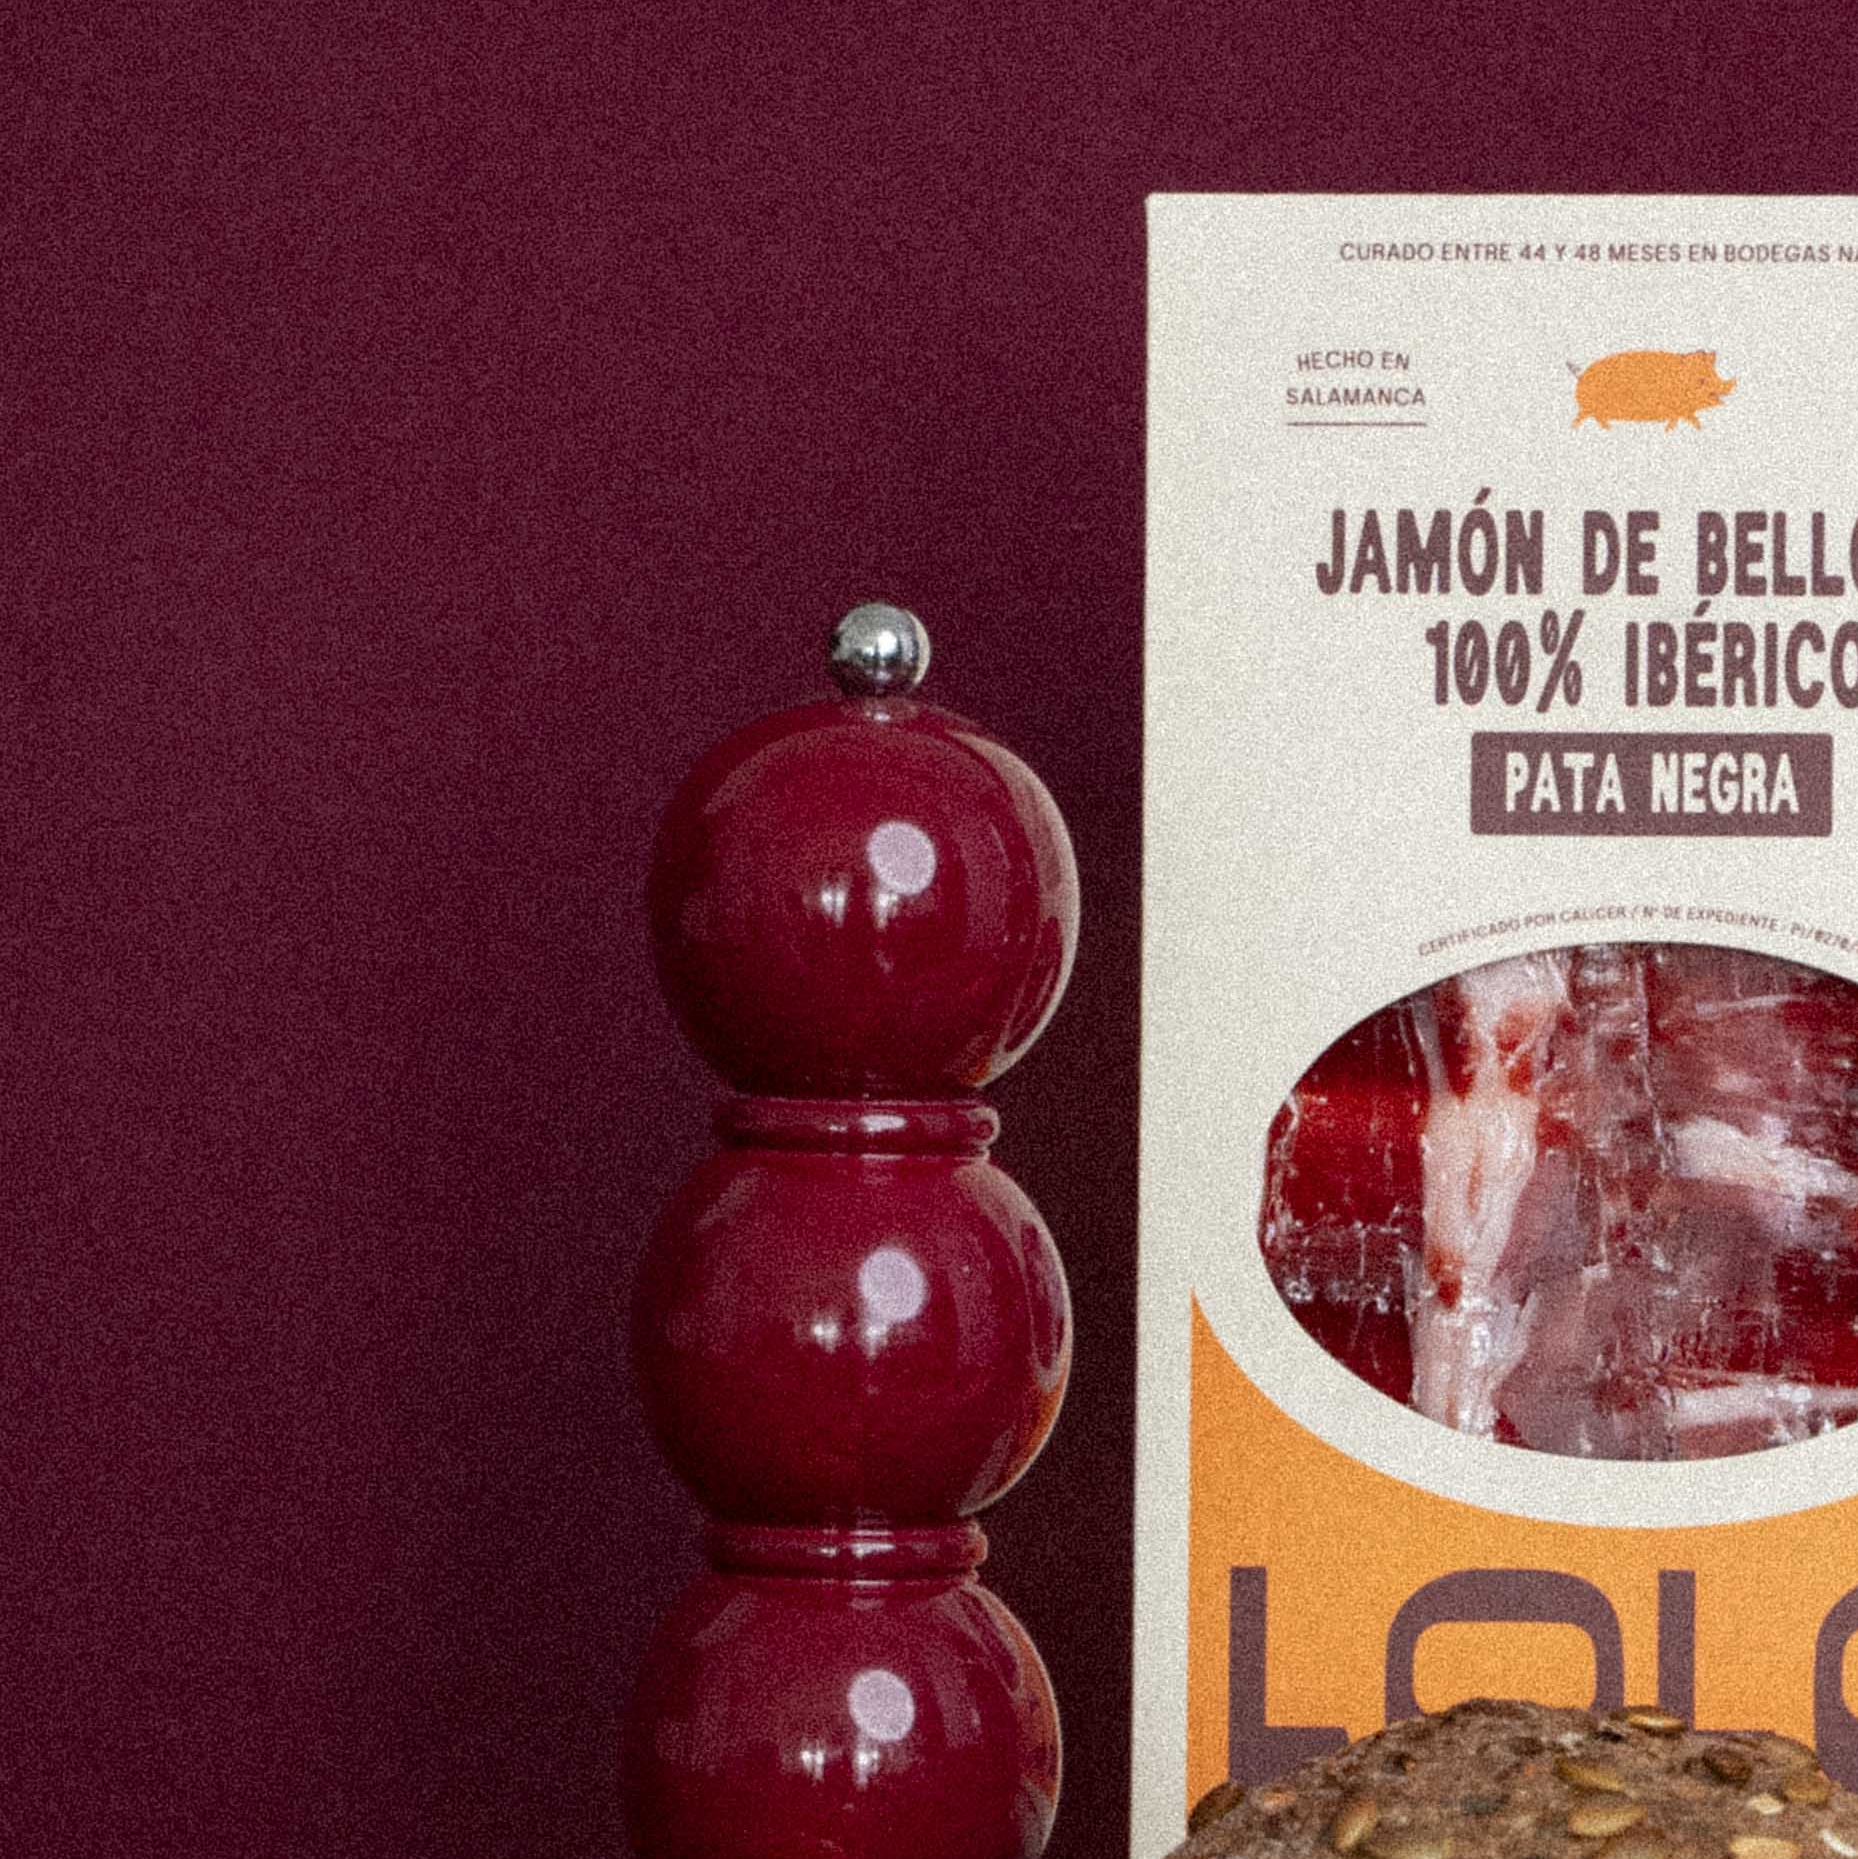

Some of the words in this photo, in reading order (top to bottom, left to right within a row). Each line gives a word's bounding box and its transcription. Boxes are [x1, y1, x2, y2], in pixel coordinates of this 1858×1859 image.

[1340, 242, 1434, 262] CURADO
[1441, 242, 1512, 262] ENTRE
[1519, 243, 1546, 262] 44
[1555, 243, 1568, 262] Y
[1573, 243, 1601, 262] 48
[1608, 243, 1681, 263] MESES
[1688, 244, 1717, 263] EN
[1723, 244, 1831, 263] BODEGAS
[1297, 350, 1374, 371] HECHO
[1381, 350, 1410, 370] EN
[1286, 387, 1426, 406] SALAMANCA
[1315, 486, 1545, 596] JAMÓN
[1582, 510, 1661, 597] DE
[1425, 608, 1586, 714] 100%
[1504, 751, 1627, 814] PATA
[1650, 751, 1800, 815] NEGRA
[1418, 918, 1521, 957] CERTIFICADO
[1525, 912, 1556, 929] POR
[1664, 905, 1681, 920] DE
